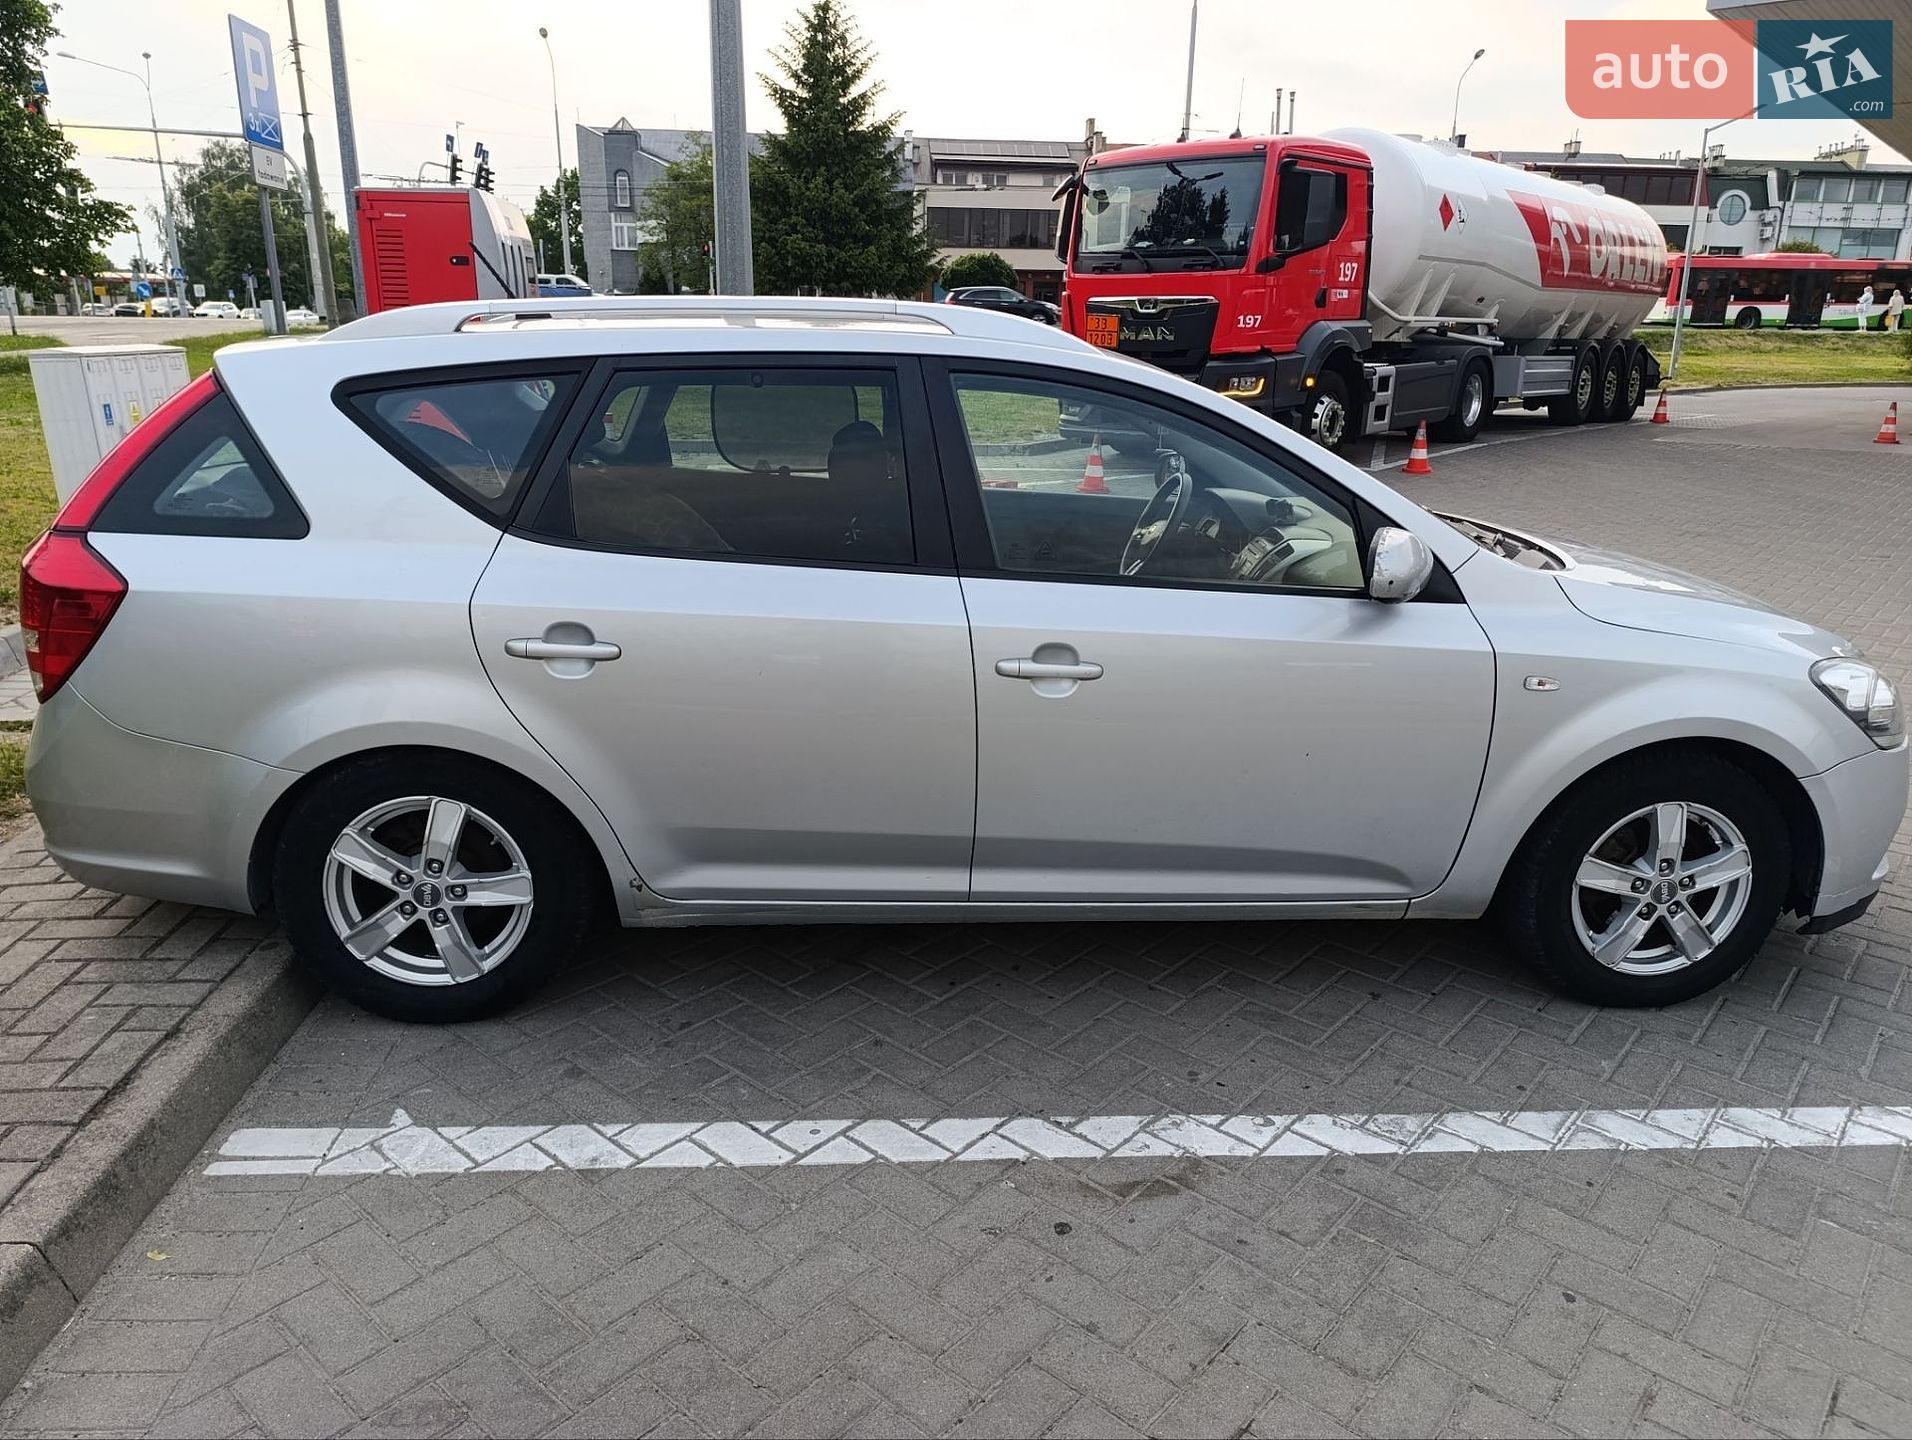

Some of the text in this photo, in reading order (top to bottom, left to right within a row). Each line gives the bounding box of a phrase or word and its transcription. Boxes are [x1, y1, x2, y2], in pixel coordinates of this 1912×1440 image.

[242, 31, 269, 108] P
[1588, 215, 1663, 284] ORLEN
[1338, 262, 1358, 282] 197
[1094, 317, 1107, 330] 33
[1237, 315, 1262, 328] 197
[1089, 333, 1113, 346] 1203
[1120, 326, 1175, 341] MAN
